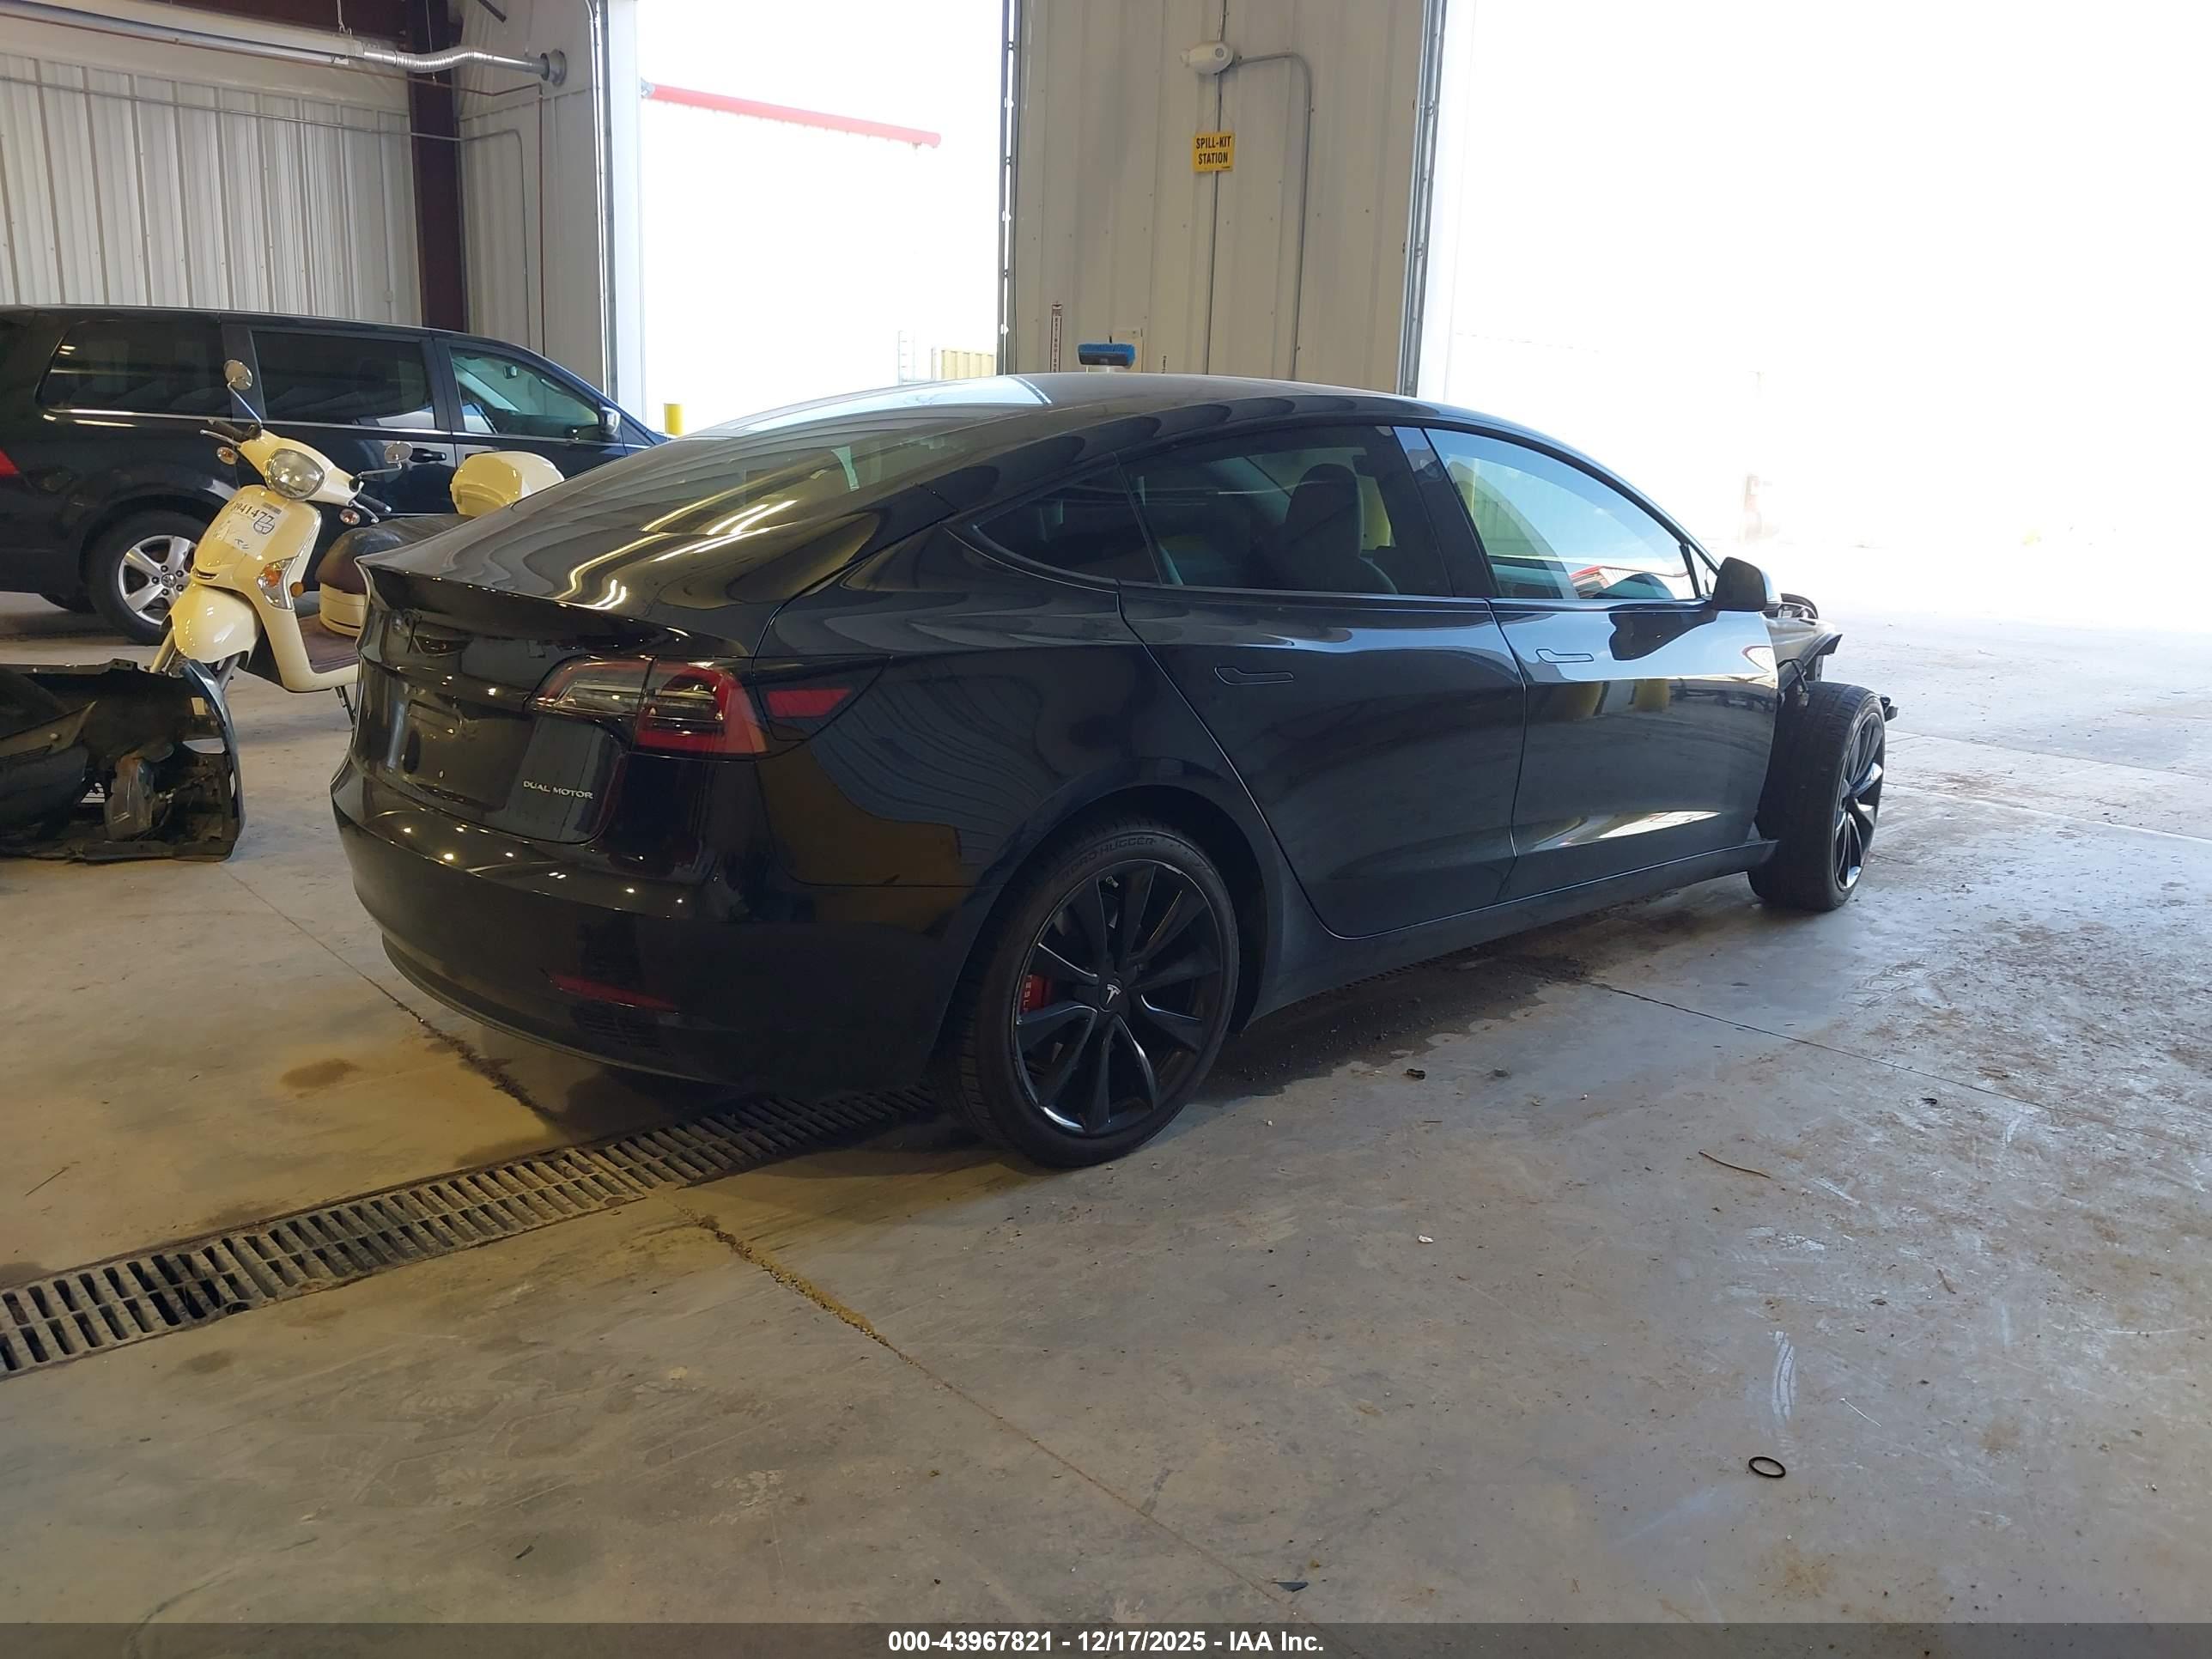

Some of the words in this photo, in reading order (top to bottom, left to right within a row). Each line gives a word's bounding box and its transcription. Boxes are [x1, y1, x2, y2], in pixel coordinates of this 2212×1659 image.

[1196, 136, 1231, 149] SPILL-KIT
[1198, 151, 1228, 165] STATION
[523, 781, 550, 793] DUAL
[552, 787, 593, 799] MOTOR
[1100, 837, 1155, 853] HUGGER
